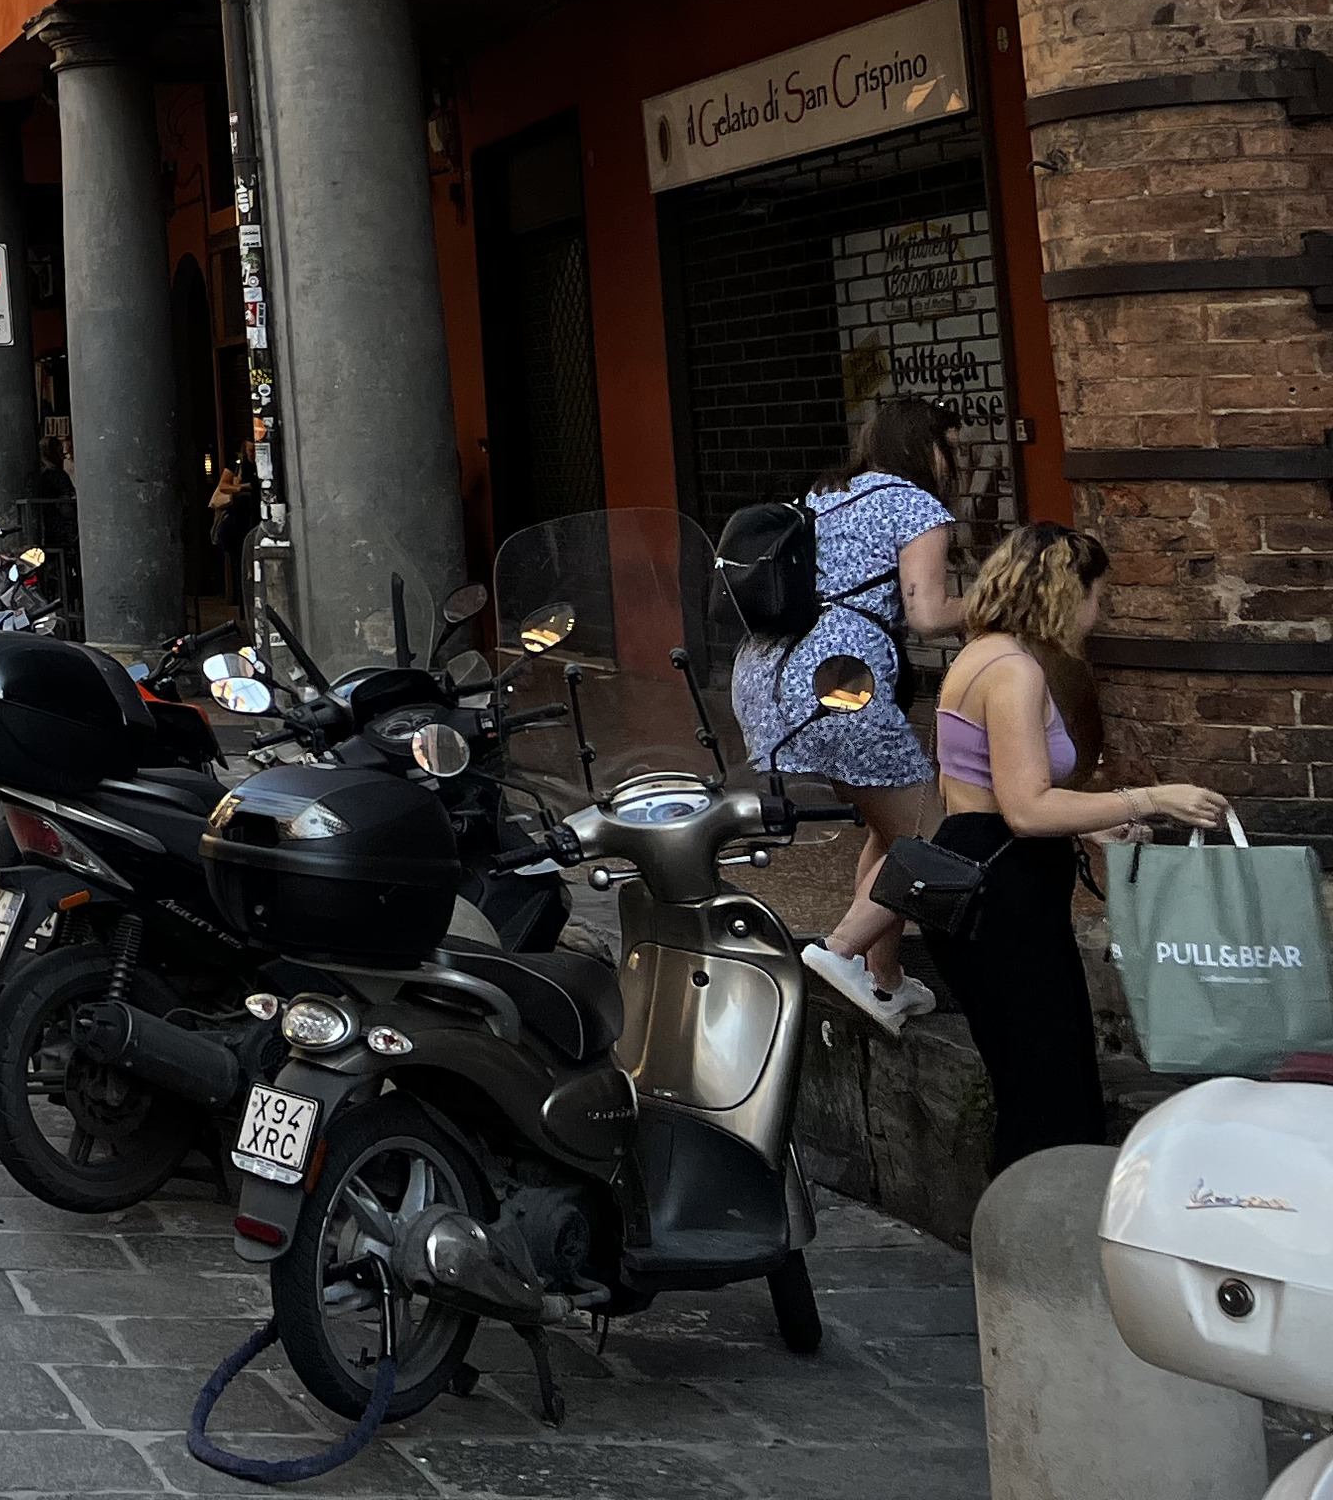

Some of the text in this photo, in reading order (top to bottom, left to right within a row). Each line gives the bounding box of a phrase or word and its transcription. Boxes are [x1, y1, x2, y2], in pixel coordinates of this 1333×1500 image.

[699, 93, 760, 147] Gelato
[764, 79, 780, 124] di
[785, 70, 828, 124] San
[832, 52, 928, 110] Crispino
[1156, 941, 1303, 968] PULL&BEAR
[254, 1092, 305, 1130] X94
[246, 1121, 296, 1160] XRC
